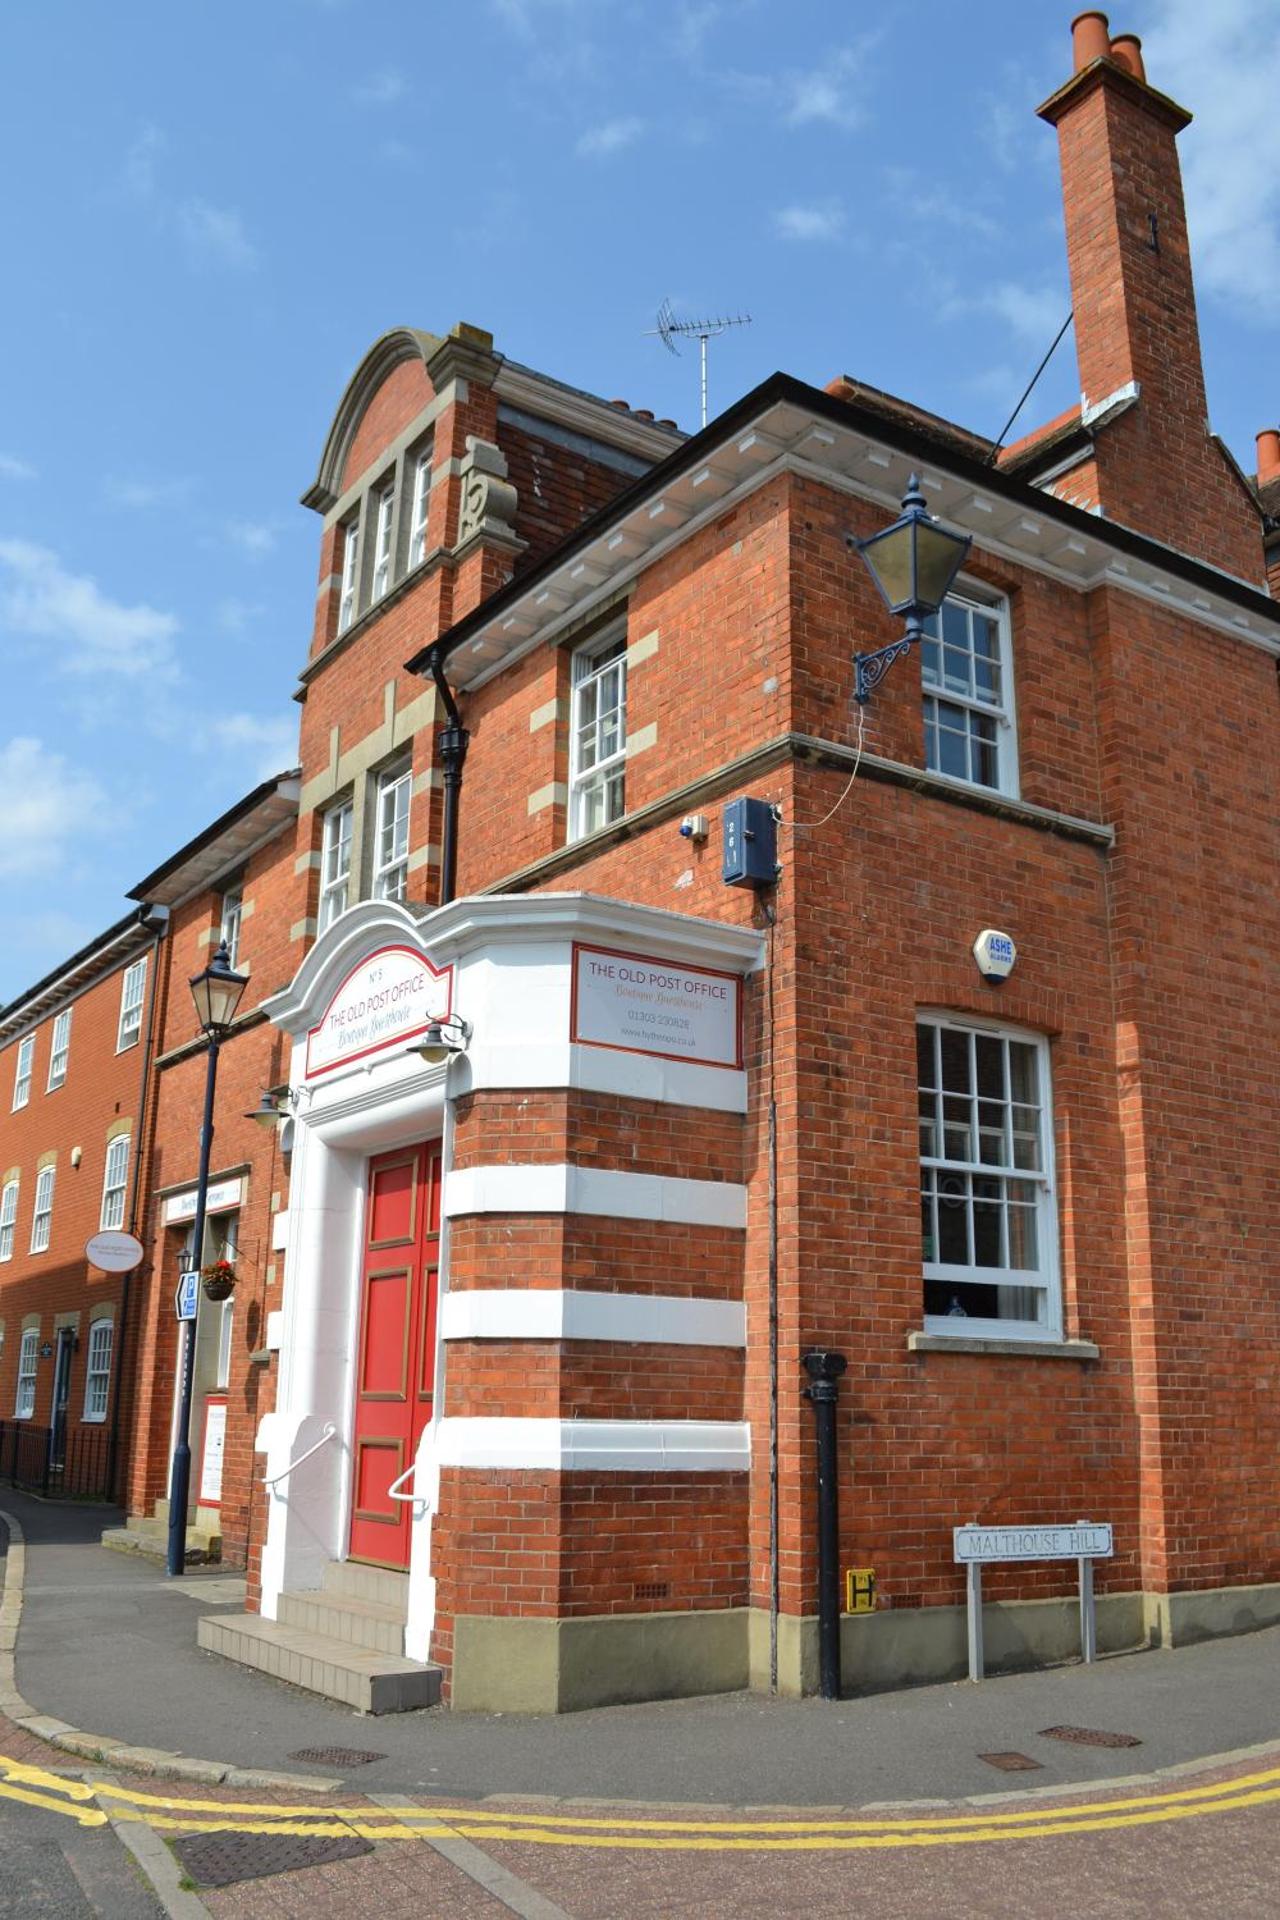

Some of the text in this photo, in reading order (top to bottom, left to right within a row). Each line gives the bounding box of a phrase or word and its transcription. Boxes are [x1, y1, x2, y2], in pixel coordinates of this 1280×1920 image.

[990, 937, 1011, 955] ASHE
[589, 962, 727, 1000] THE OLD POST OFFICE
[330, 973, 425, 1030] THE OLD POST OFFICE
[969, 1532, 1100, 1554] MALTHOUSE HILL
[852, 1574, 873, 1609] H
